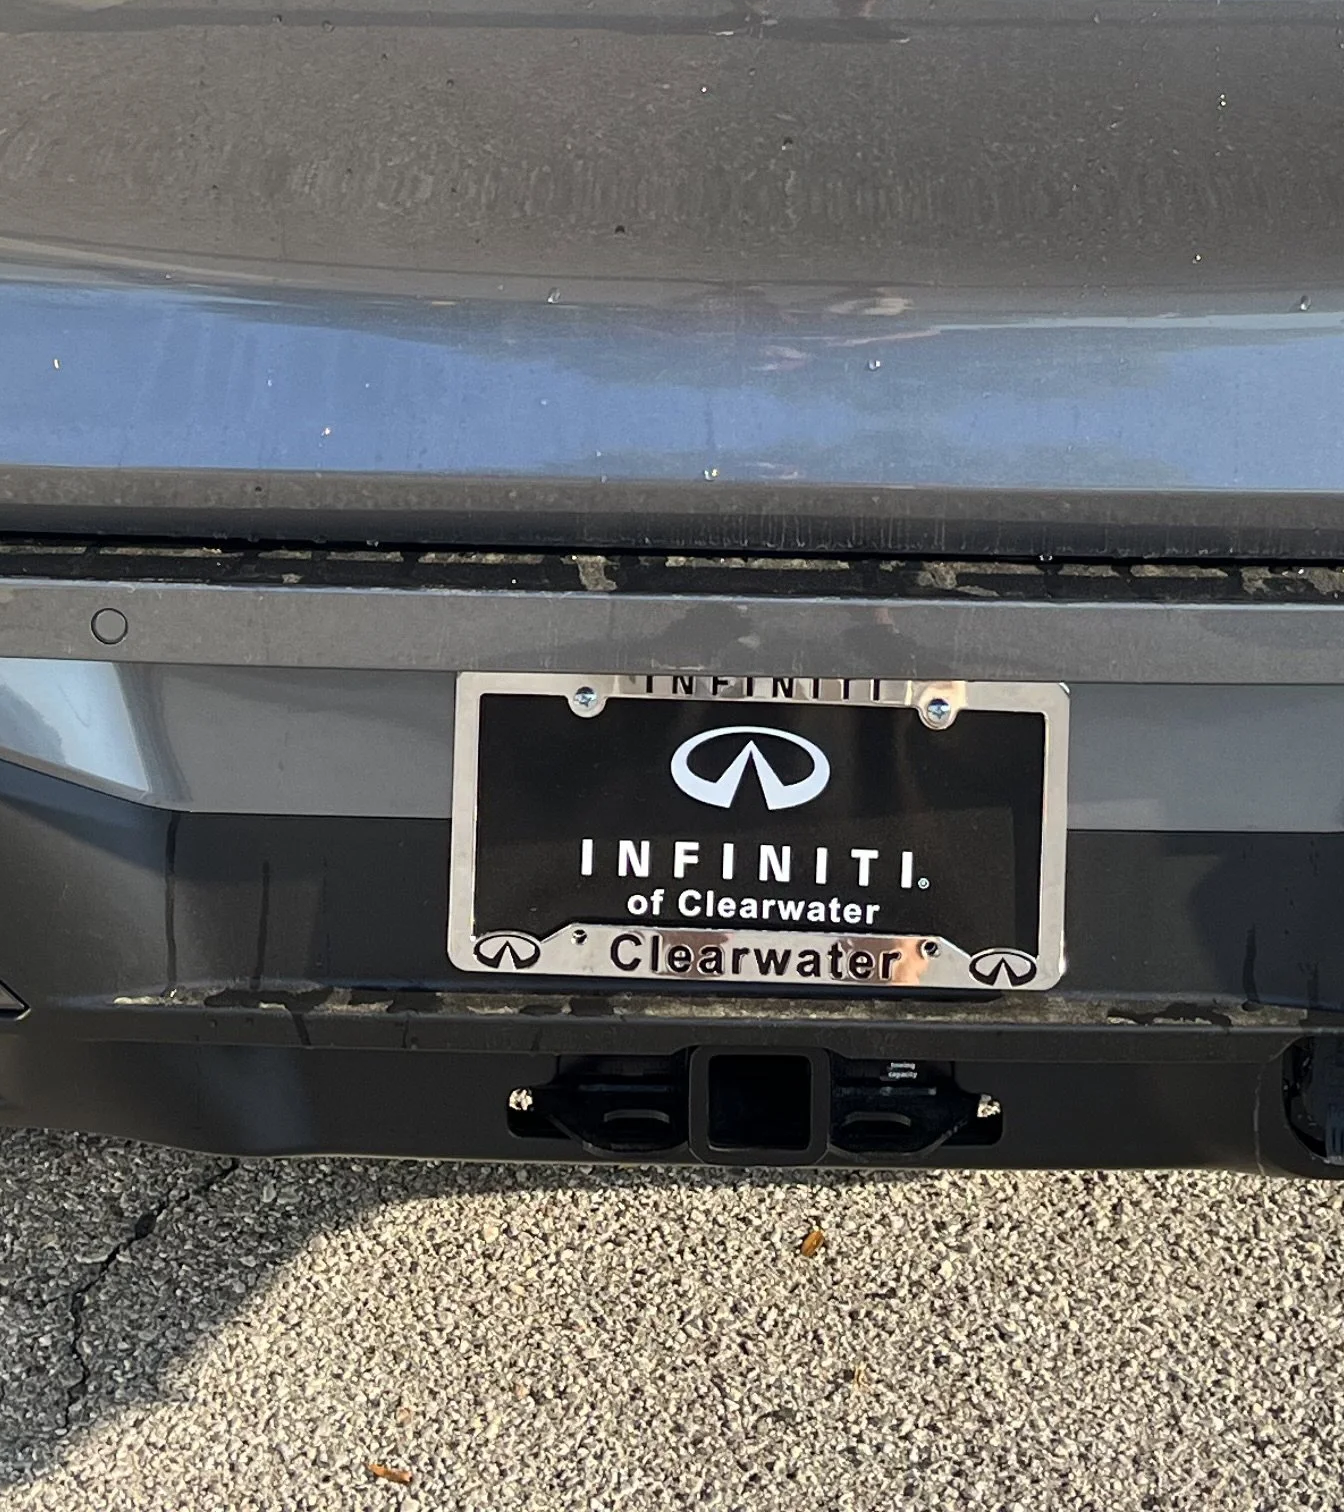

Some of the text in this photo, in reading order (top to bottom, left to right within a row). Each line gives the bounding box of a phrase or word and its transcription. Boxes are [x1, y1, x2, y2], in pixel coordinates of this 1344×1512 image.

[580, 838, 914, 889] INFINITI
[627, 889, 881, 925] of Clearwater
[609, 932, 903, 981] Clearwater
